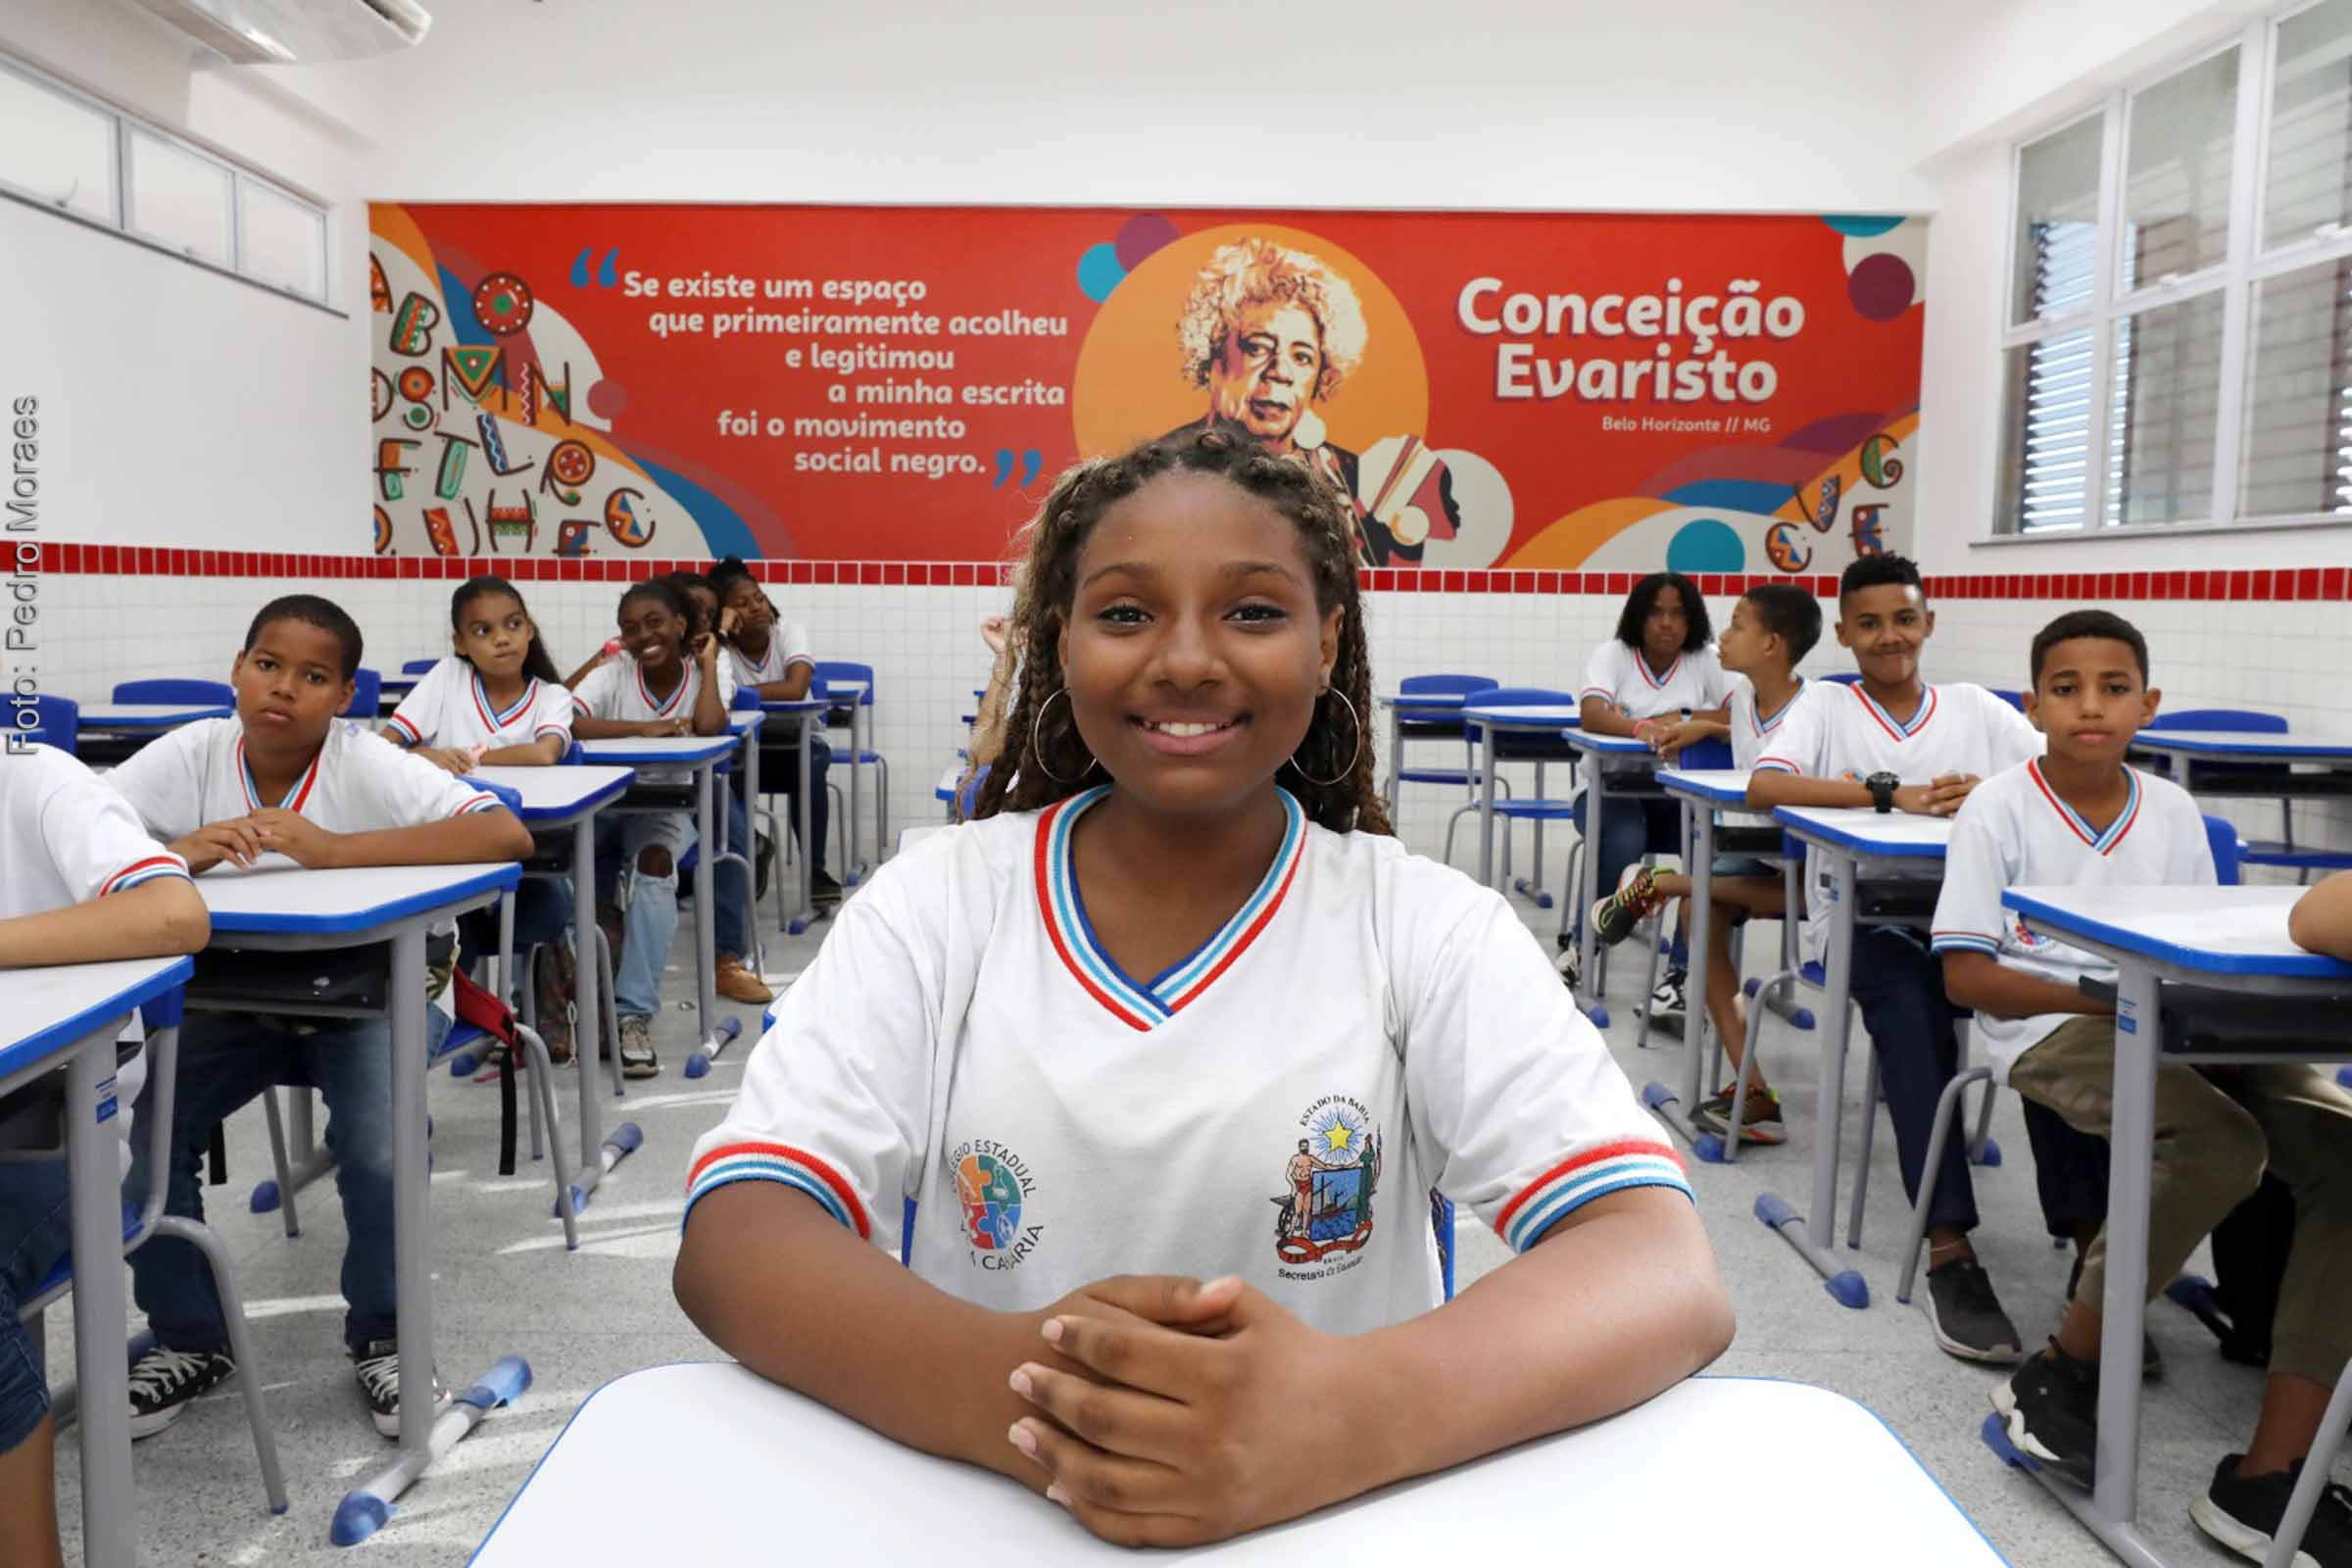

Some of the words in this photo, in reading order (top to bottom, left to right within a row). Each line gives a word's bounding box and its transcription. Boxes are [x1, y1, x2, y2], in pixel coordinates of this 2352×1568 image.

[622, 270, 660, 298] Se
[667, 270, 756, 298] existe
[764, 279, 813, 299] um
[821, 278, 927, 308] espaço
[648, 311, 705, 339] que
[712, 310, 941, 338] primeiramente
[948, 310, 1068, 337] acolheu
[1457, 276, 1805, 354] Conceição
[784, 348, 802, 368] e
[810, 342, 955, 375] legitimou
[1496, 341, 1779, 402] Evaristo
[827, 383, 847, 404] a
[855, 378, 954, 406] minha
[960, 378, 1065, 407] escrita
[716, 409, 759, 437] foi
[765, 417, 785, 436] o
[794, 411, 966, 439] movimento
[1601, 416, 1637, 431] Belo
[1642, 416, 1721, 432] Horizonte
[1743, 418, 1771, 433] MG
[794, 445, 882, 472] social
[890, 452, 986, 479] negro.
[974, 1139, 1037, 1200] ESTADUAL
